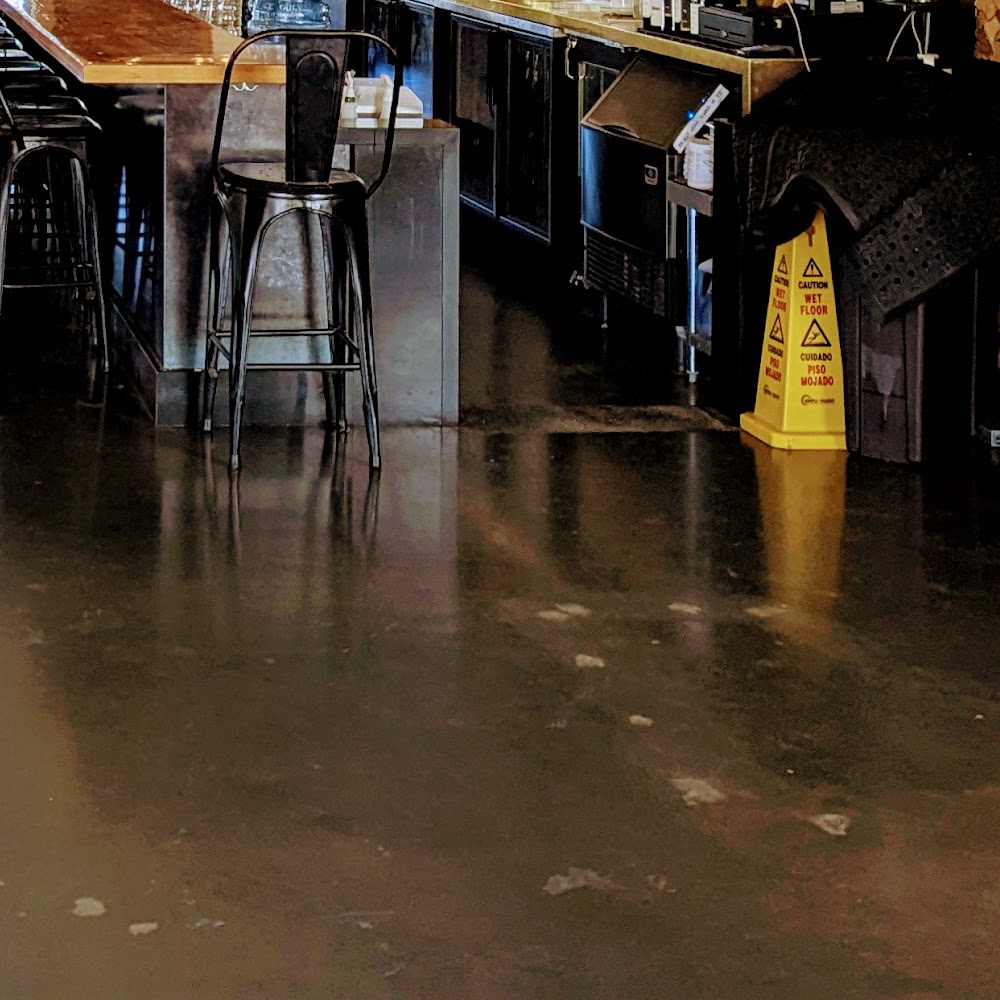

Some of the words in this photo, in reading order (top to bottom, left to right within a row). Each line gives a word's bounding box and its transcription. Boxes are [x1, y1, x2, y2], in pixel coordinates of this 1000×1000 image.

[798, 281, 828, 289] CAUTION
[804, 293, 822, 304] WET
[800, 304, 828, 315] FLOOR
[800, 352, 833, 361] CUIDADO
[807, 364, 826, 375] PISO
[800, 376, 834, 386] MOJADO
